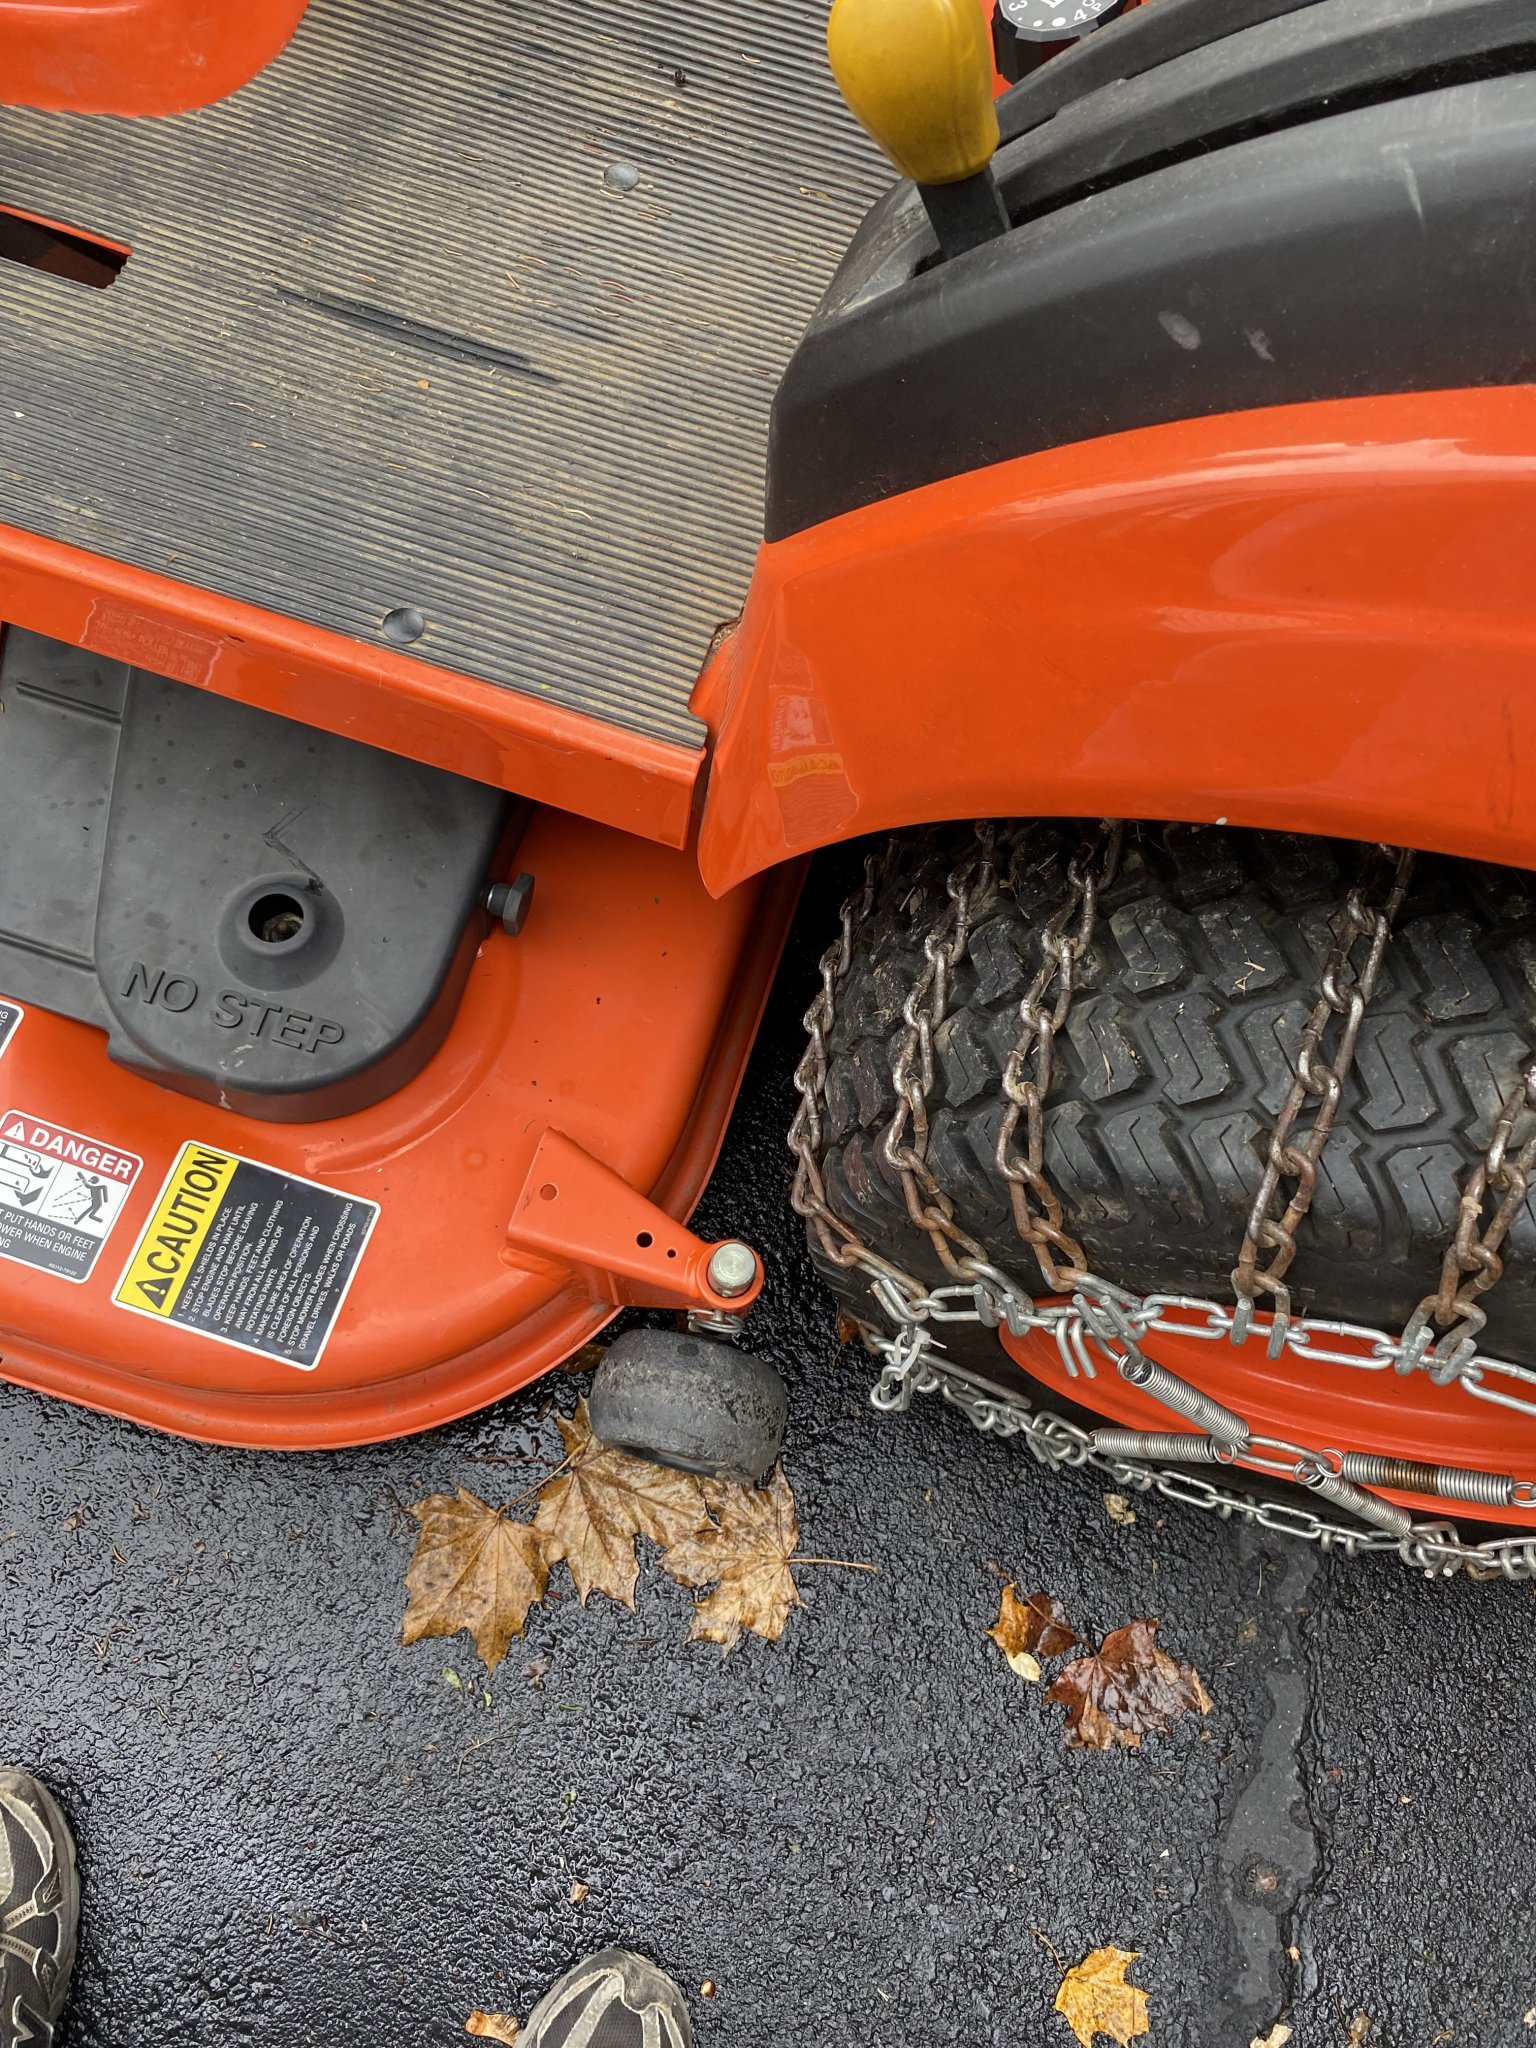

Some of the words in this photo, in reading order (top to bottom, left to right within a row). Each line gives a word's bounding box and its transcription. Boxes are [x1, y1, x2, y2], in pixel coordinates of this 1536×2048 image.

[1074, 8, 1088, 21] 4
[121, 961, 198, 1013] NO
[209, 990, 345, 1053] STEP
[29, 1127, 133, 1180] DANGER
[4, 1211, 24, 1225] PUT
[24, 1218, 57, 1237] HANDS
[58, 1230, 72, 1243] OR
[72, 1236, 95, 1250] FEET
[24, 1231, 52, 1249] WHEN
[52, 1242, 87, 1262] ENGINE
[147, 1151, 228, 1274] CAUTION
[192, 1291, 206, 1313] STOP
[202, 1262, 219, 1291] ENGINE
[215, 1244, 227, 1262] AND
[223, 1225, 236, 1245] WAIT
[231, 1203, 246, 1225] UNTIL
[203, 1286, 221, 1316] BLADES
[216, 1264, 231, 1286] STOP
[226, 1233, 244, 1264] BEFORE
[240, 1201, 259, 1233] LEAVING
[181, 1287, 195, 1309] KEEP
[191, 1273, 202, 1288] ALL
[197, 1240, 217, 1273] SHIELDS
[212, 1231, 221, 1241] IN
[213, 1278, 237, 1320] OPERATOR
[224, 1302, 238, 1324] KEEP
[246, 1253, 260, 1273] FEET
[255, 1236, 267, 1254] AND
[263, 1199, 284, 1237] CLOTHING
[235, 1305, 249, 1328] AWAY
[244, 1282, 259, 1306] FROM
[254, 1268, 265, 1283] ALL
[261, 1238, 279, 1268] MOVING
[274, 1225, 284, 1238] OR
[256, 1312, 270, 1335] MAKE
[266, 1290, 280, 1312] SURE
[275, 1269, 289, 1290] AREA
[284, 1258, 294, 1269] OF
[289, 1215, 313, 1258] OPERATION
[267, 1329, 275, 1339] IS
[271, 1303, 287, 1330] CLEAR
[282, 1291, 292, 1303] OF
[287, 1277, 298, 1292] ALL
[293, 1241, 314, 1277] PERSONS
[309, 1224, 321, 1241] AND
[288, 1324, 302, 1346] STOP
[297, 1294, 315, 1324] MOWER
[310, 1264, 327, 1293] BLADES
[322, 1240, 337, 1264] WHEN
[332, 1202, 354, 1241] CROSSING
[298, 1318, 317, 1350] GRAVEL
[324, 1261, 341, 1288] WALKS
[336, 1249, 346, 1262] OR
[245, 1292, 267, 1331] ROTATING
[277, 1307, 297, 1342] FOREIGN
